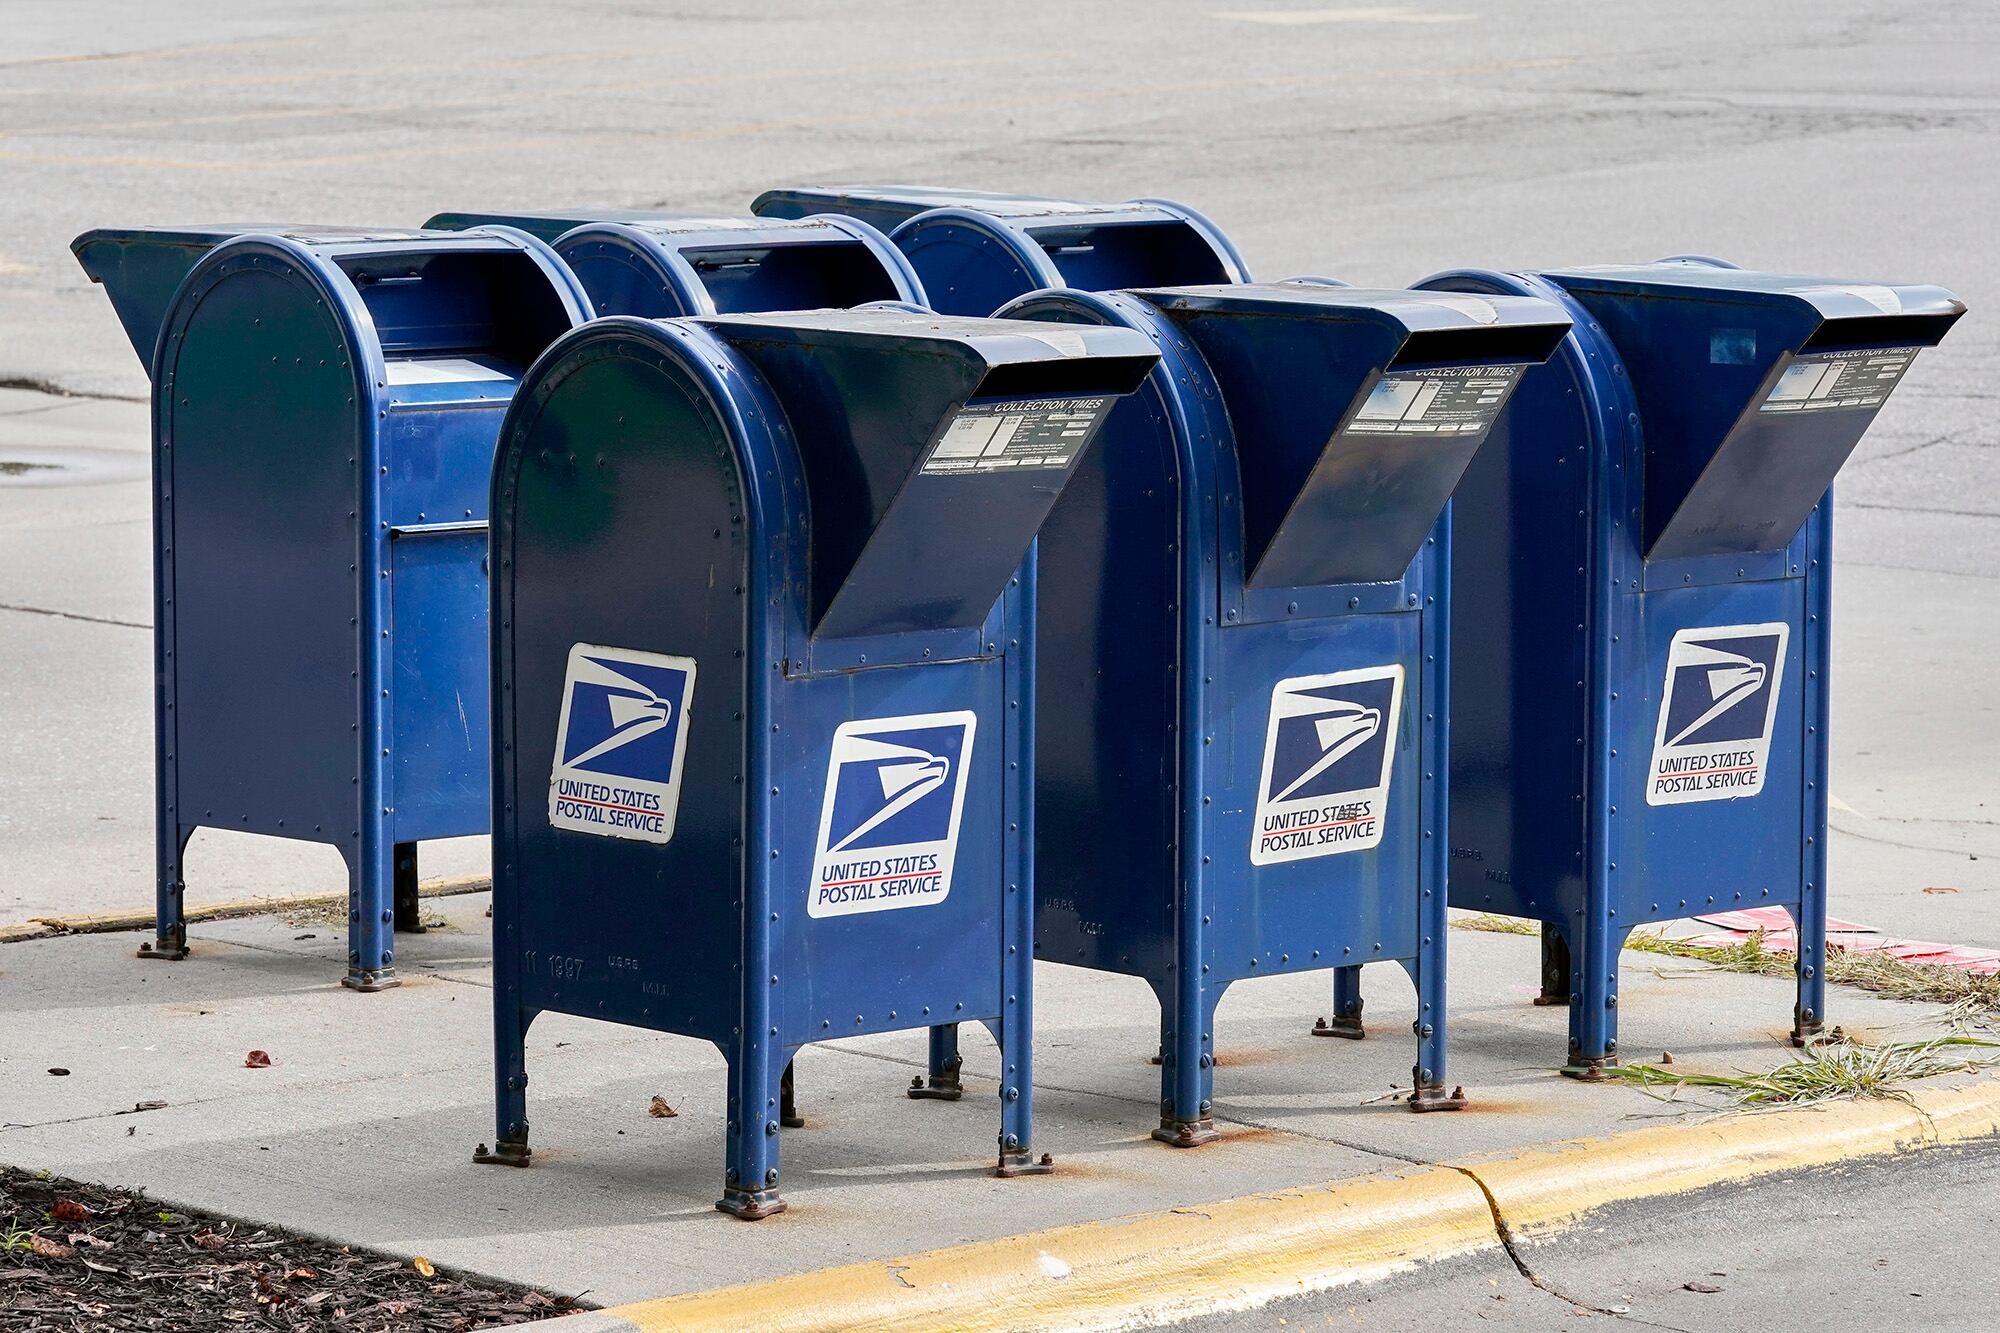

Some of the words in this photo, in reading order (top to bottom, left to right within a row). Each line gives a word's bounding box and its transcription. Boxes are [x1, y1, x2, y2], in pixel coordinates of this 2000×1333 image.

[1483, 366, 1517, 376] TIMES
[994, 401, 1065, 413] COLLECTION
[1067, 399, 1104, 410] TIMES
[1658, 755, 1708, 774] UNITED
[1709, 750, 1755, 768] STATES
[559, 779, 611, 802] UNITED
[611, 788, 661, 811] STATES
[1655, 775, 1704, 794] POSTAL
[1705, 770, 1758, 789] SERVICE
[556, 800, 606, 824] POSTAL
[607, 809, 665, 834] SERVICE
[1263, 809, 1319, 832] UNITED
[1320, 801, 1371, 823] STATES
[1260, 831, 1315, 853] POSTAL
[1316, 821, 1376, 845] SERVICE
[822, 860, 881, 882] UNITED
[882, 854, 938, 876] STATES
[818, 883, 876, 905] POSTAL
[878, 875, 942, 898] SERVICE
[549, 955, 585, 982] 1997
